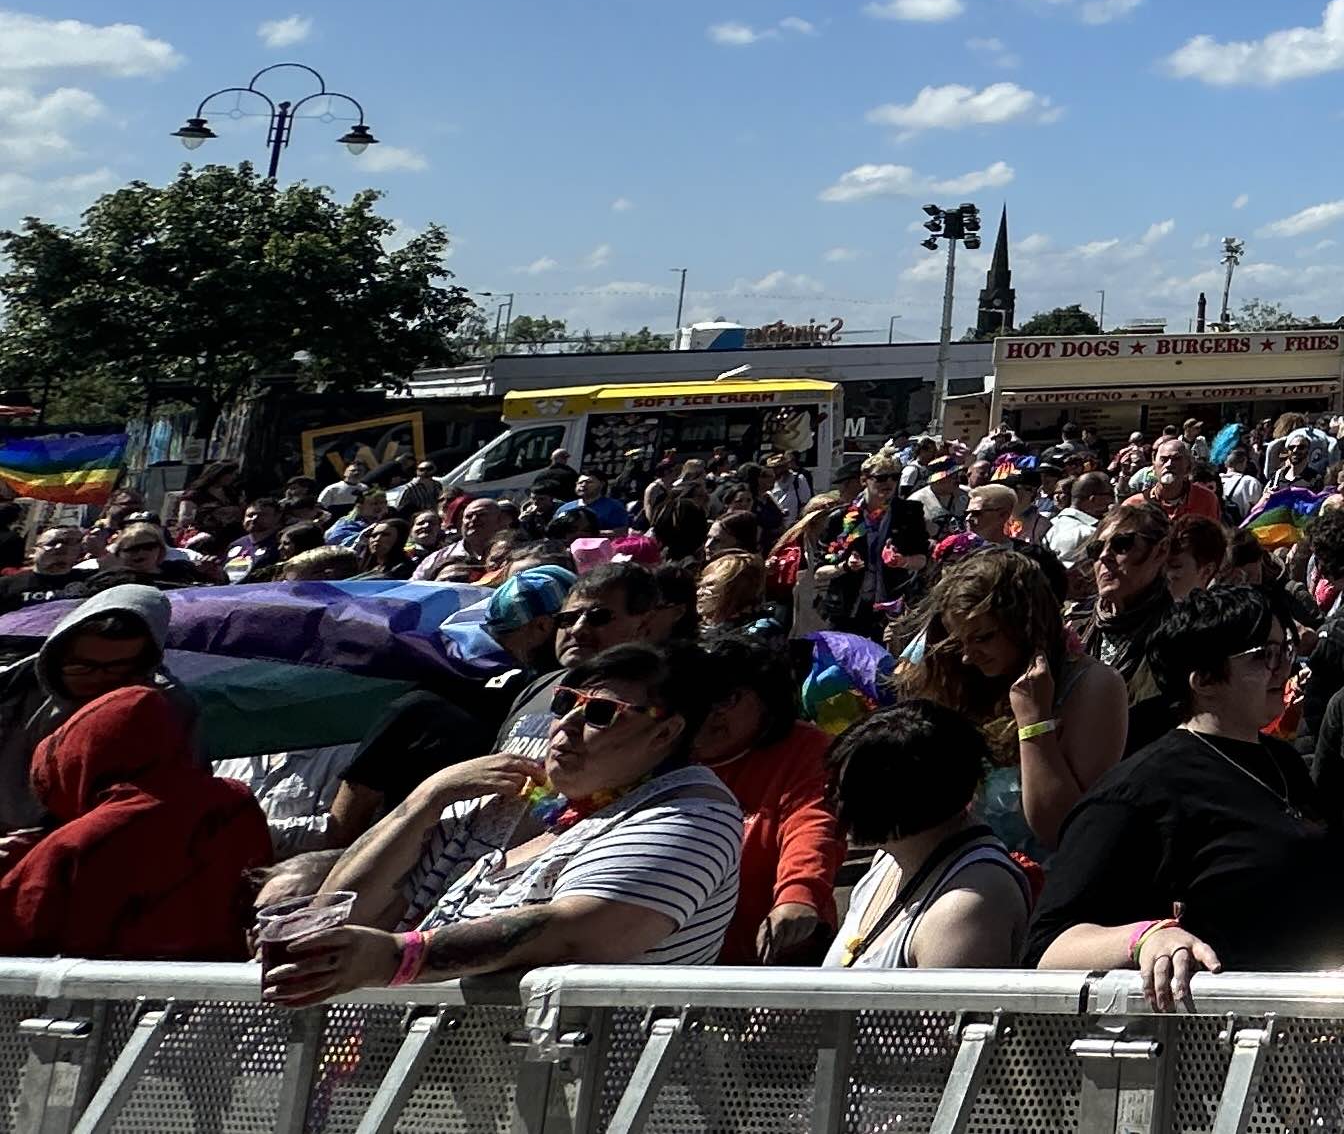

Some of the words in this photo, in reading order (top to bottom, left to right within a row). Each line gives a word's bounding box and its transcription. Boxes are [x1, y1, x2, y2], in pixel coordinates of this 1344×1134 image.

[1006, 342, 1056, 359] HOT
[1060, 340, 1120, 358] DOGS
[1155, 337, 1251, 355] BURGERS
[1284, 335, 1339, 352] FRIES
[633, 396, 681, 409] SOFT
[682, 395, 716, 406] ICE
[718, 393, 776, 405] CREAM
[1024, 391, 1123, 403] CAPPUCCINO
[1150, 390, 1177, 400] TEA
[1202, 387, 1257, 399] COFFEE
[1281, 384, 1324, 395] LATTE
